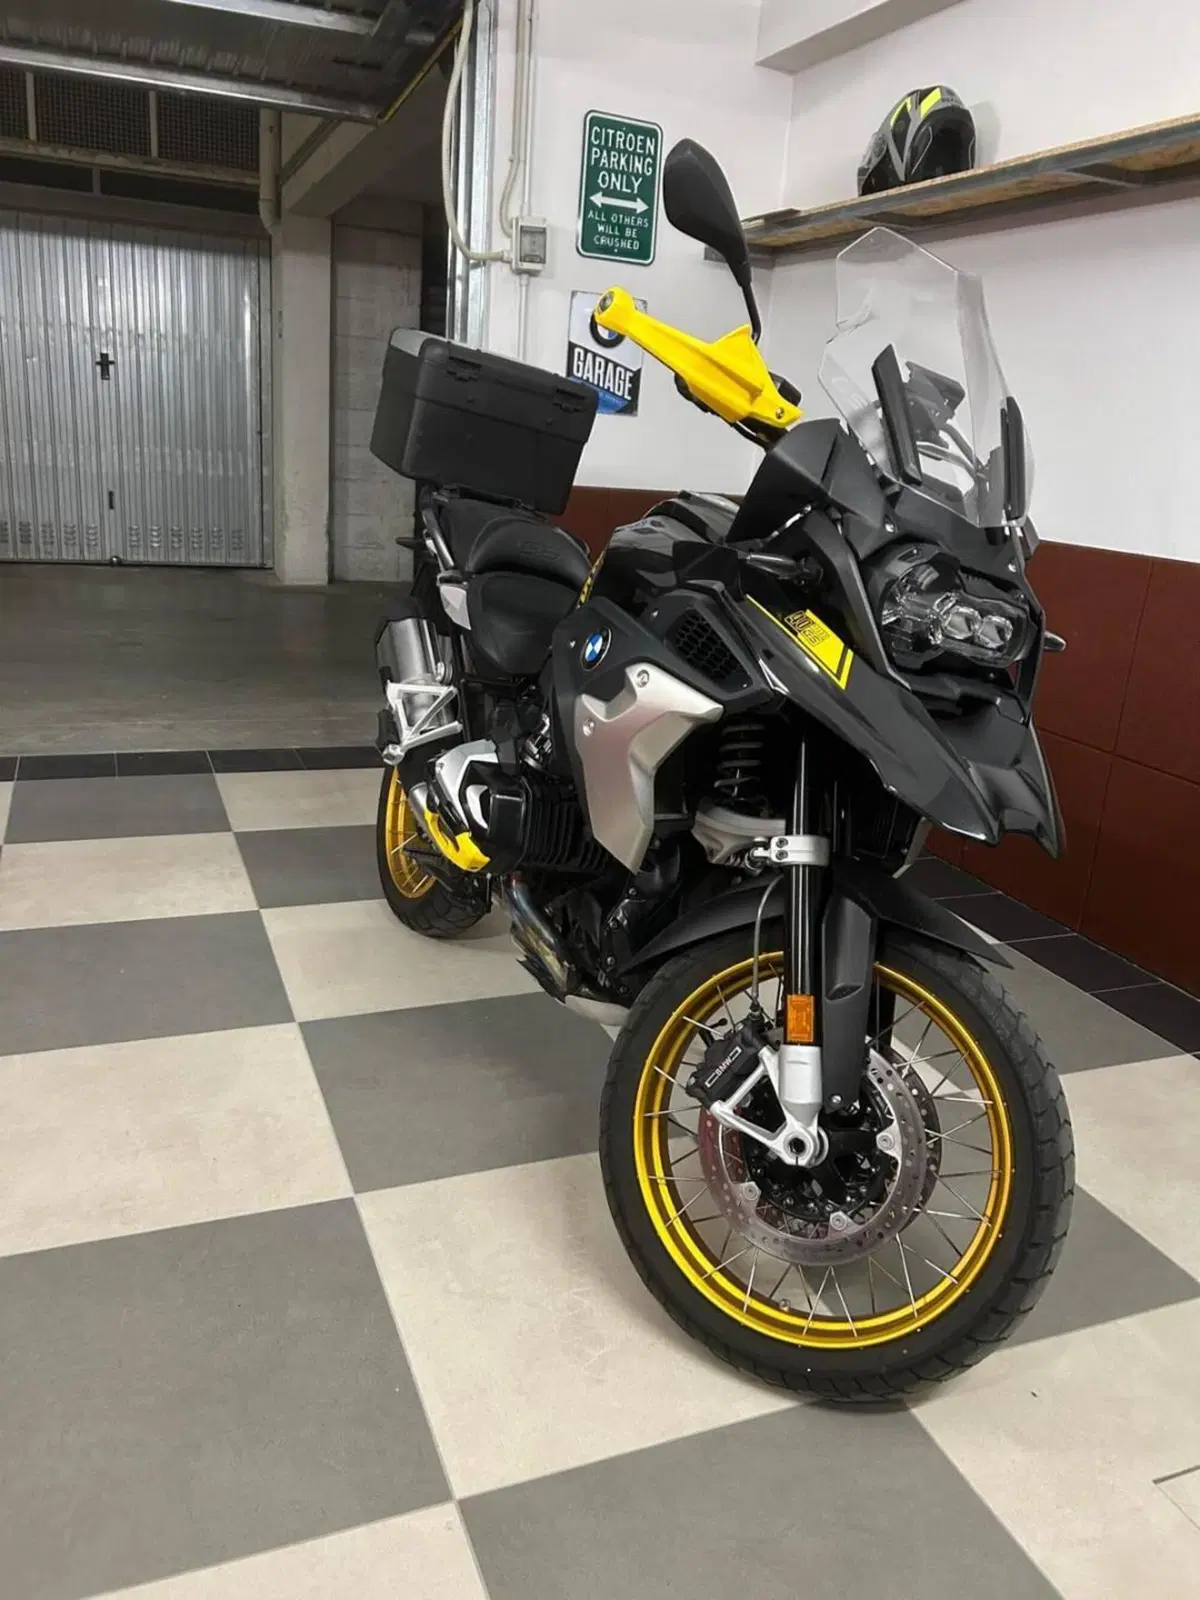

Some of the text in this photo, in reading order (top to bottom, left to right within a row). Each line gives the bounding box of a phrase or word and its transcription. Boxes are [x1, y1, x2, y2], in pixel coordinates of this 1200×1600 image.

[591, 126, 655, 155] CITROEN
[591, 148, 653, 176] PARKING
[598, 171, 643, 194] ONLY
[588, 210, 649, 227] ALL OTHERS
[597, 224, 638, 238] WILL BE
[593, 237, 640, 250] CRUSHED
[573, 347, 634, 400] GARAGE
[715, 1056, 732, 1077] BMW
